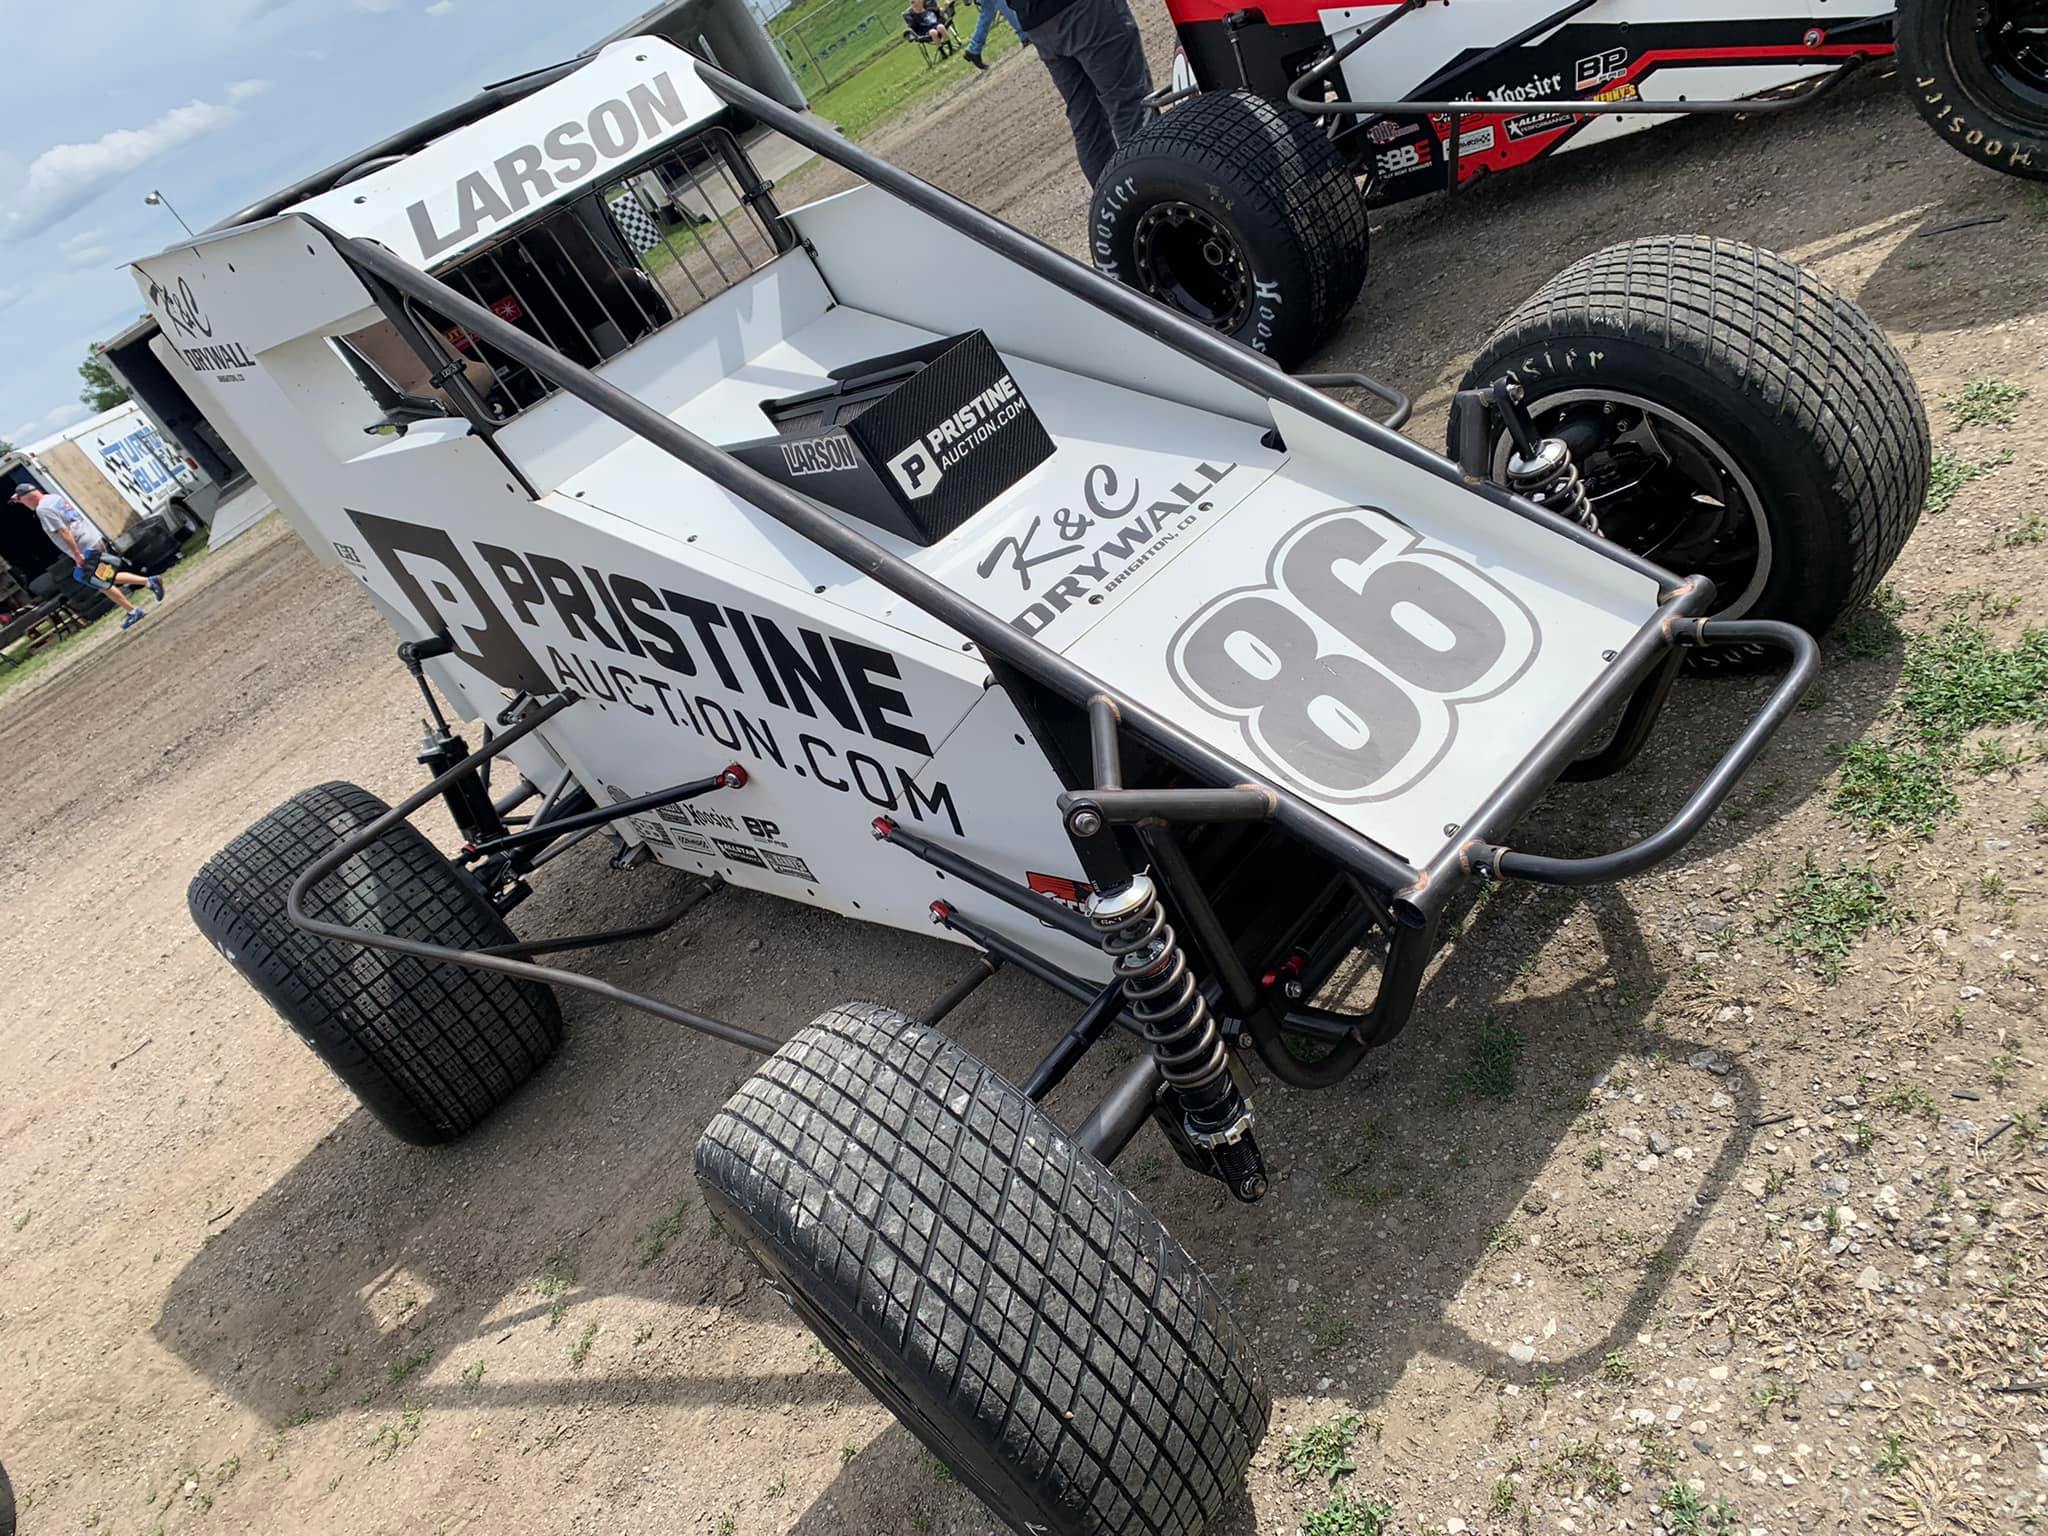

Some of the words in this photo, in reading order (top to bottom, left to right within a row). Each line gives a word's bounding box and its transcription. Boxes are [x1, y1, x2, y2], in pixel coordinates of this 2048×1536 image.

[406, 71, 689, 261] LARSON
[182, 342, 256, 371] DRYWALL
[926, 374, 1018, 454] PRISTINE
[941, 397, 1027, 471] AUCTION.COM
[782, 436, 858, 476] LARSON
[1009, 462, 1238, 637] DRYWALL
[1104, 531, 1180, 593] BRIGHTON,
[1177, 515, 1197, 532] CO
[472, 541, 934, 758] PRISTINE
[1174, 510, 1526, 799] 86
[547, 645, 965, 837] AUCTION.COM
[682, 803, 739, 832] Hoosier
[741, 816, 780, 839] BP
